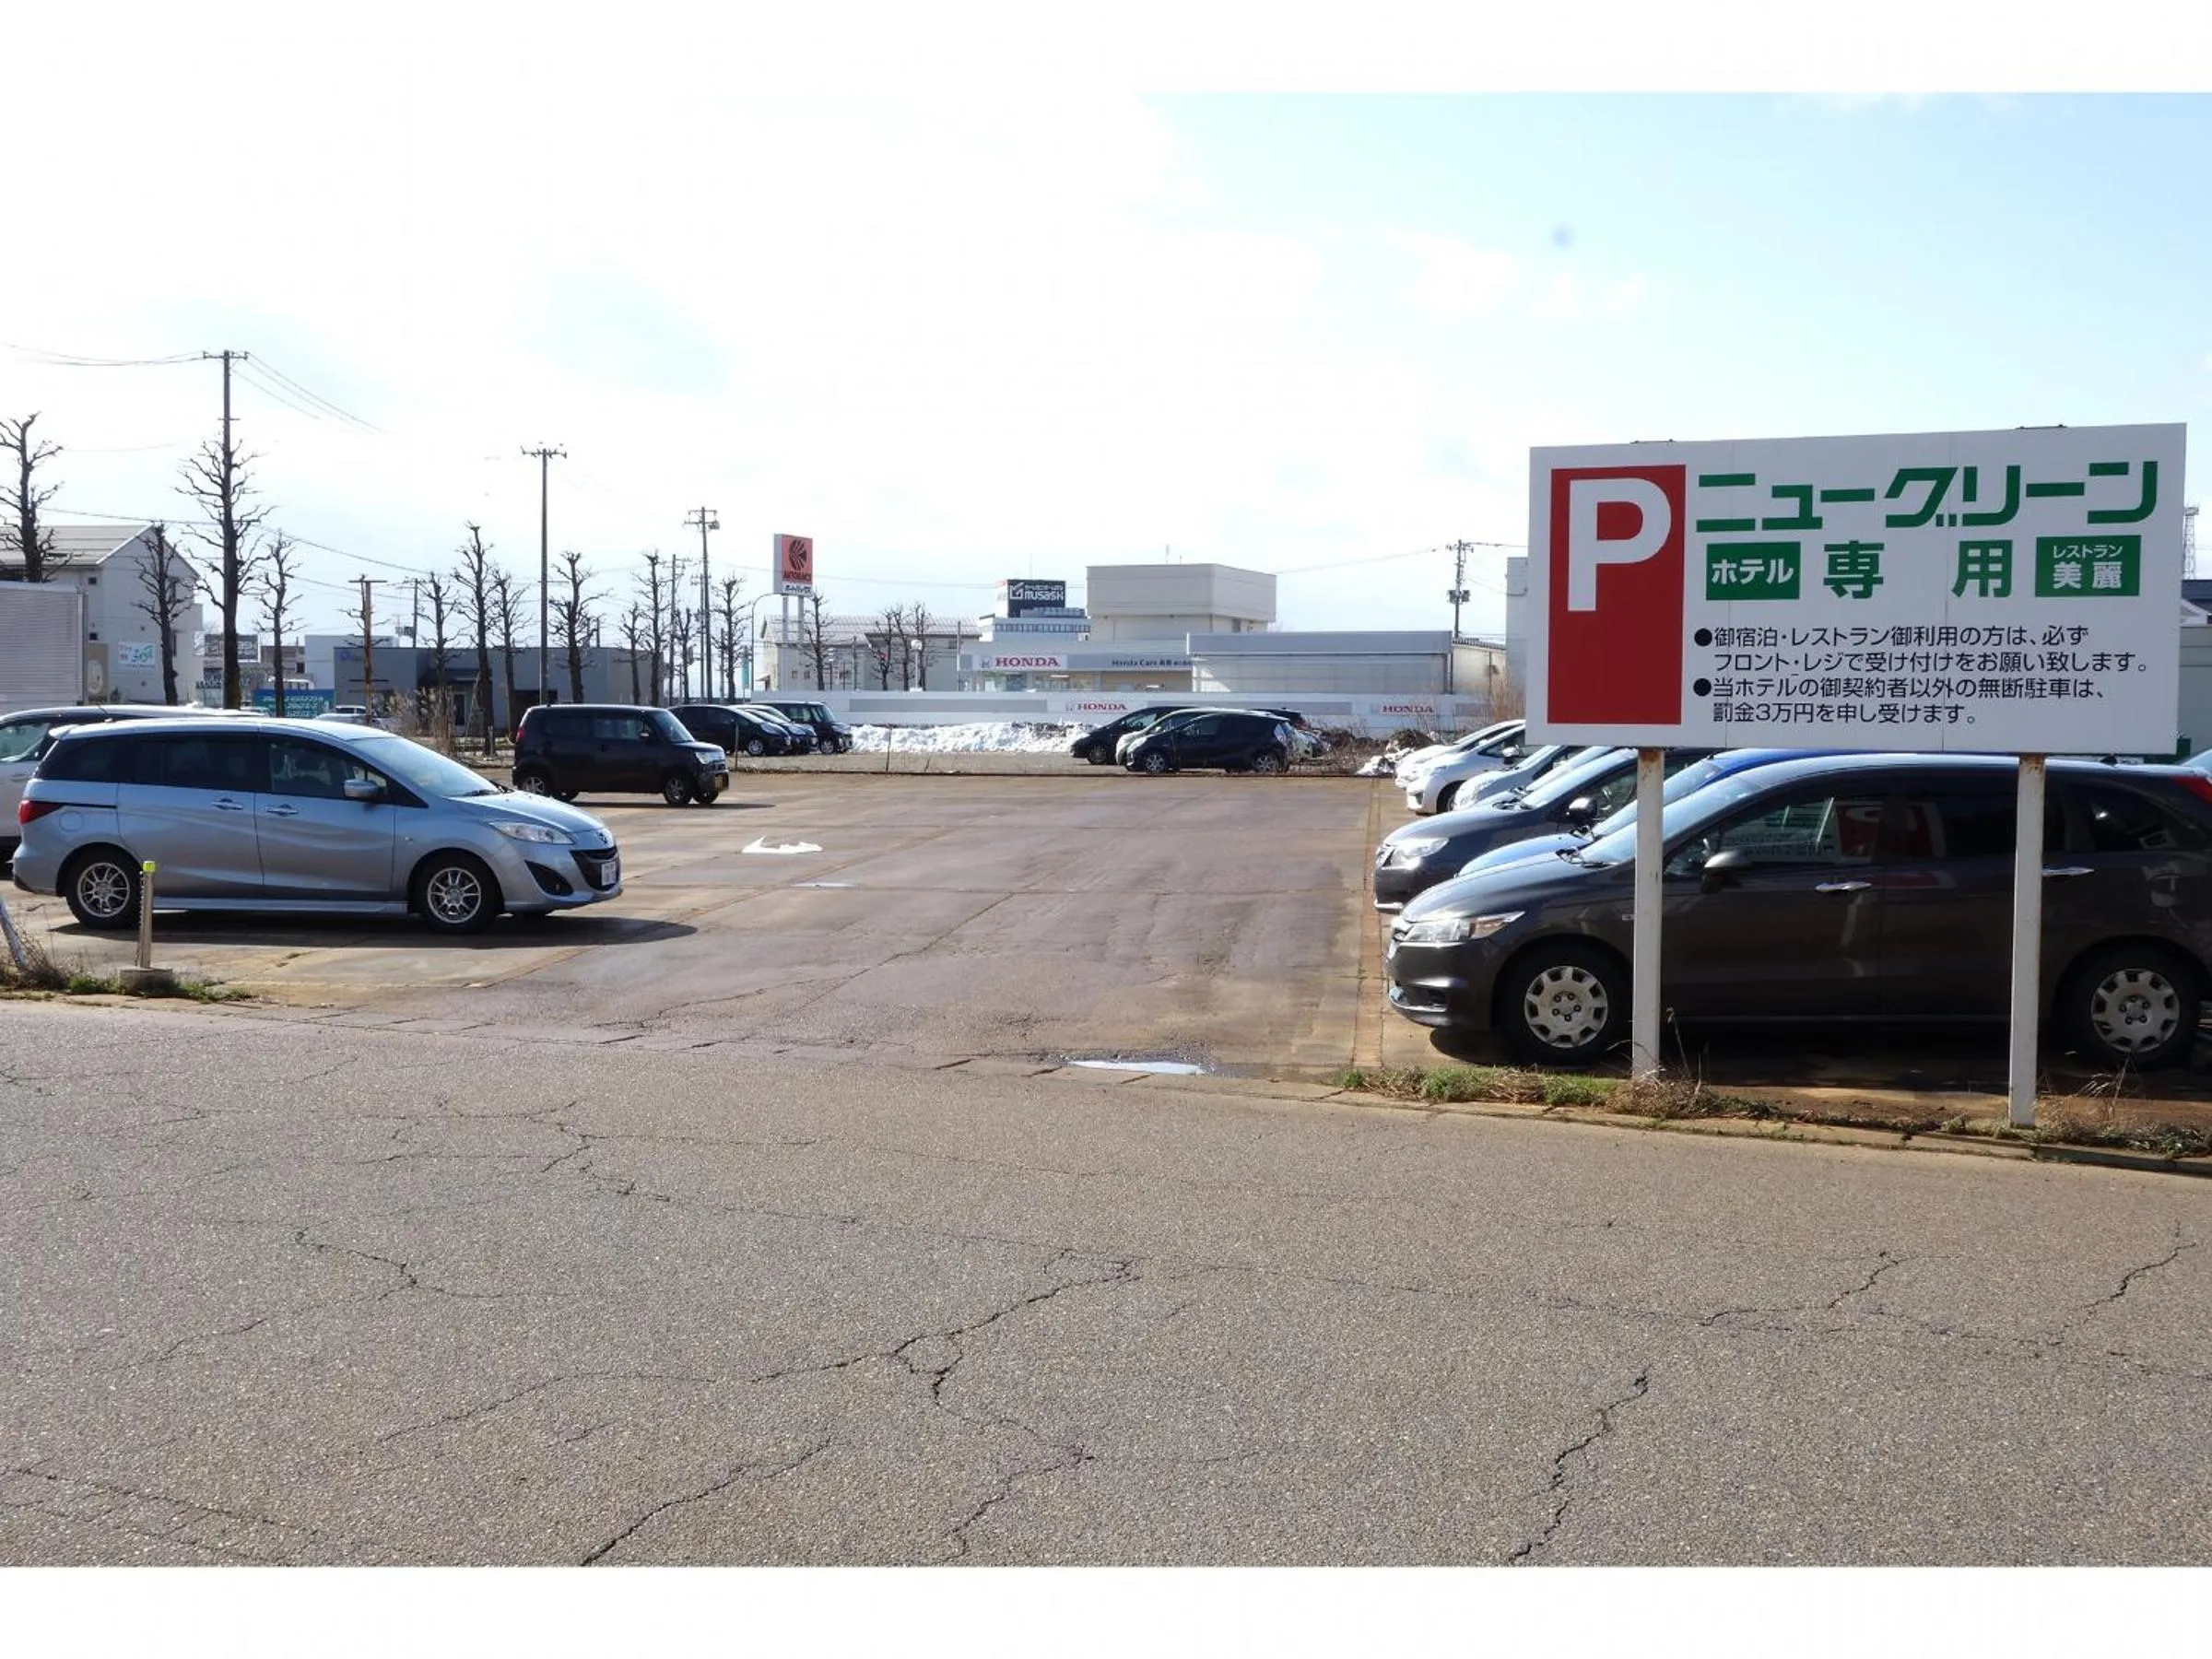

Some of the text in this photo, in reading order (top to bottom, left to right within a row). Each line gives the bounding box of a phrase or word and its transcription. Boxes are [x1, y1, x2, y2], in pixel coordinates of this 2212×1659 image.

[1697, 461, 2158, 532] ニューグリーン
[1568, 477, 1672, 612] P
[2053, 544, 2123, 559] レストラン
[1711, 557, 1794, 587] ホテル
[995, 657, 1061, 668] HONDA
[1077, 702, 1128, 712] HONDA
[1382, 705, 1434, 714] HONDA
